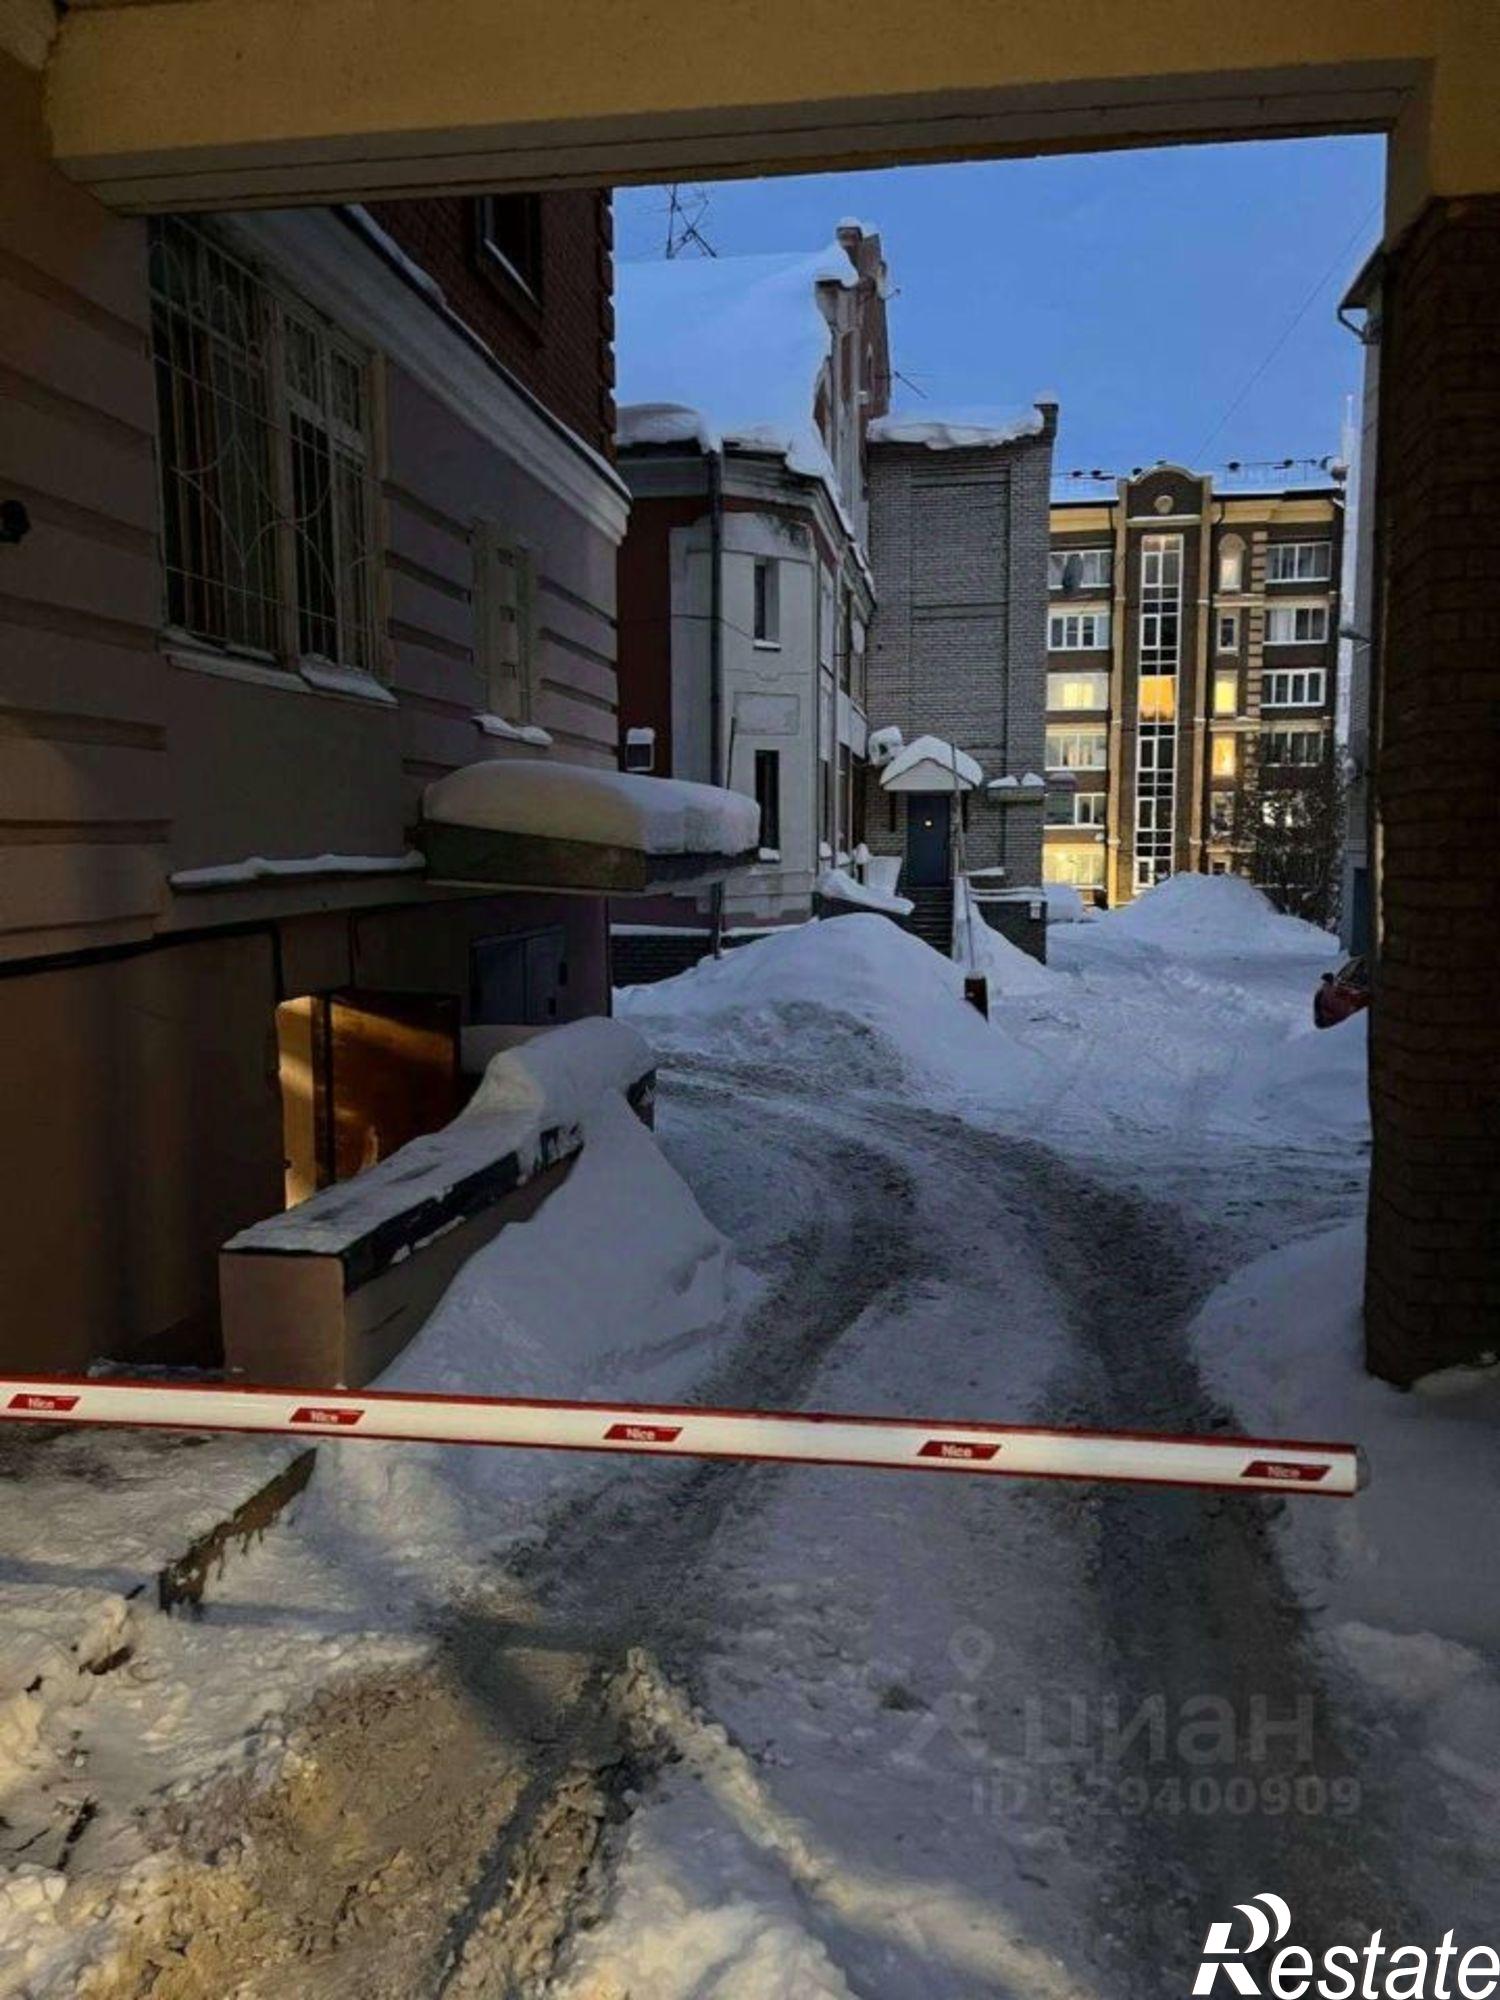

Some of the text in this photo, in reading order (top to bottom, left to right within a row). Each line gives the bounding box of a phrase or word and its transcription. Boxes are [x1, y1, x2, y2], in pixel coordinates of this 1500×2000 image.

[28, 1397, 55, 1409] Nice
[311, 1410, 339, 1423] Nice
[626, 1428, 656, 1441] Nice
[941, 1443, 972, 1457] Nice
[1267, 1465, 1300, 1479] Nice
